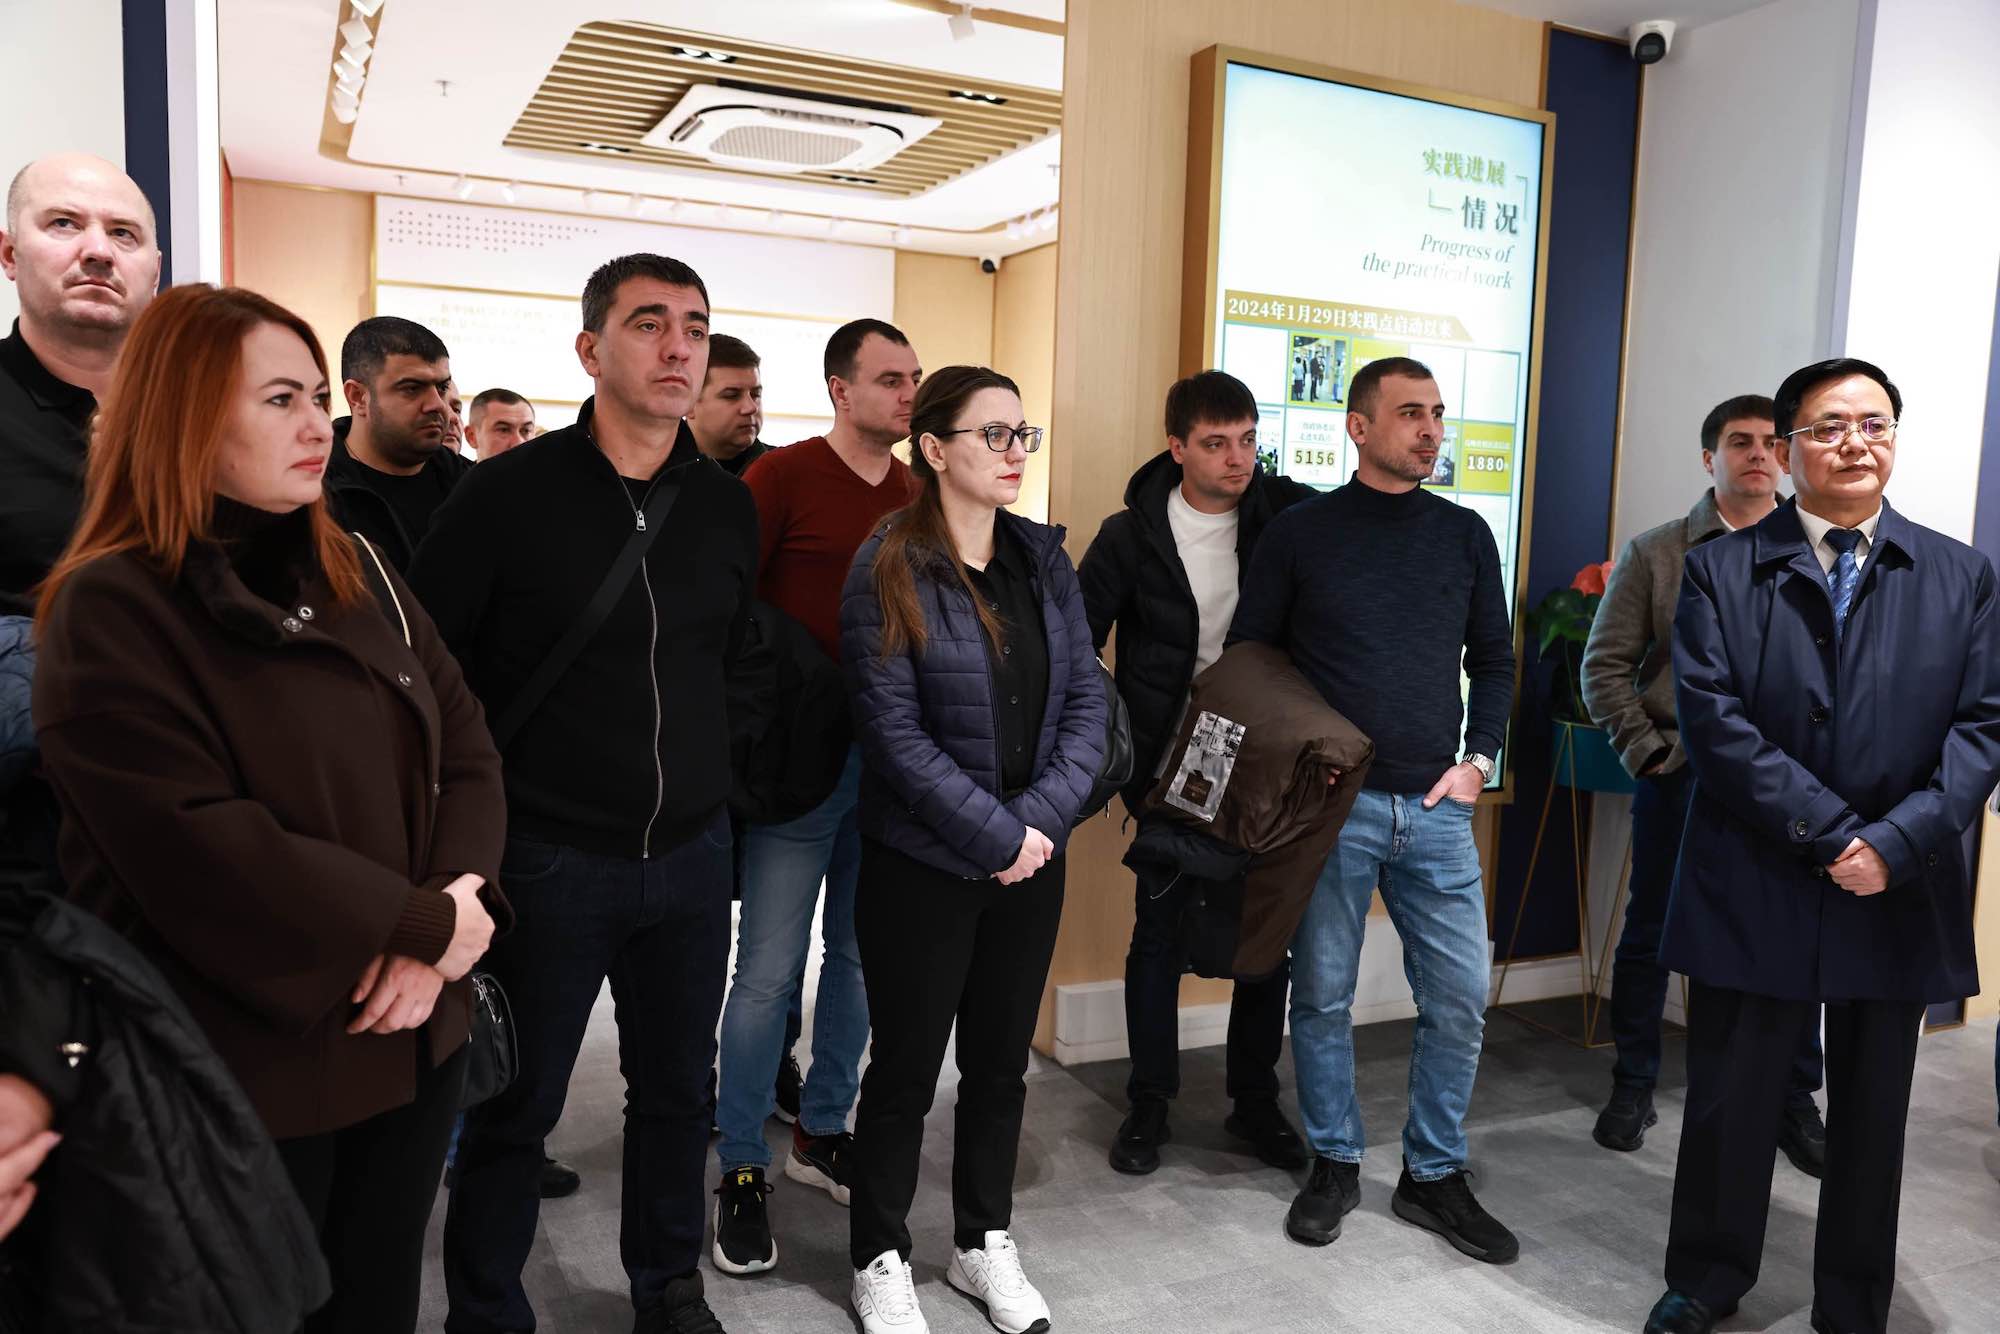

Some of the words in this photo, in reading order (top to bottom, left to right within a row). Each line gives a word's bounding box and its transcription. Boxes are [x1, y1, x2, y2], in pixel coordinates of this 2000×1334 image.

[1423, 149, 1505, 185] 实践进展
[1462, 196, 1518, 234] 情况
[1421, 234, 1491, 259] Progress
[1496, 245, 1515, 263] of
[1362, 253, 1390, 272] the
[1394, 261, 1469, 283] practical
[1473, 271, 1513, 289] work
[1295, 450, 1335, 466] 5156
[1468, 455, 1504, 471] 1880
